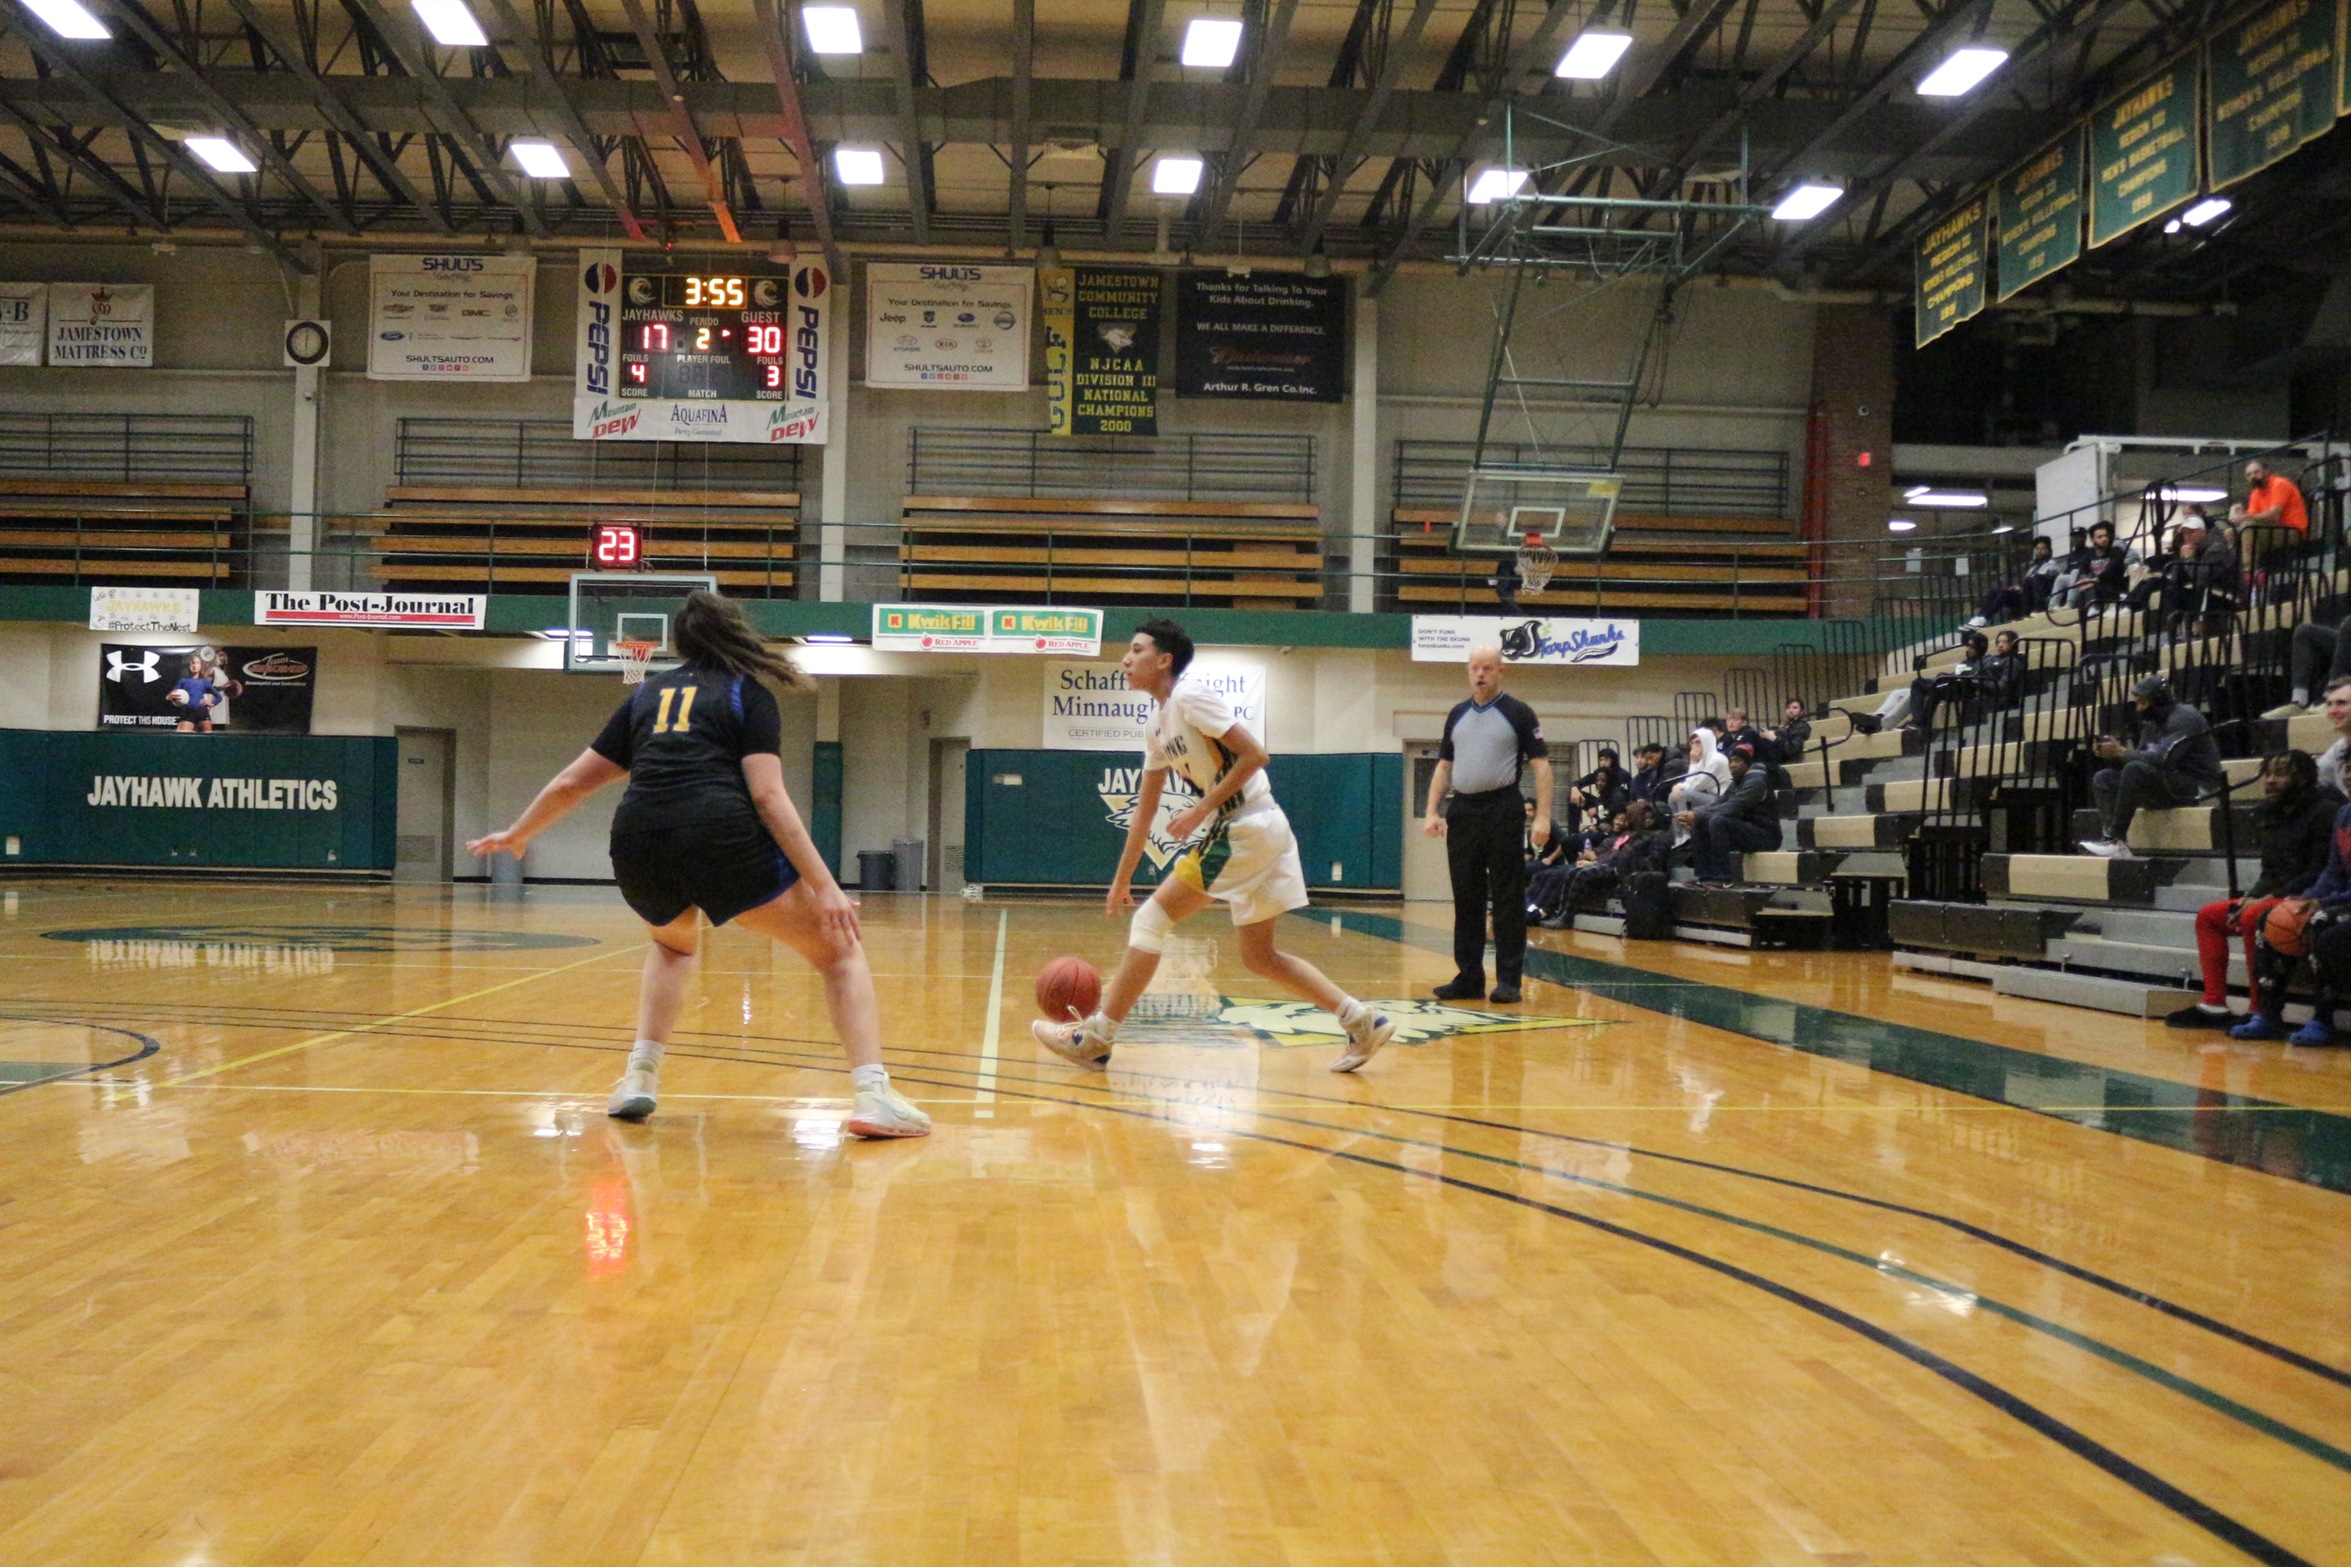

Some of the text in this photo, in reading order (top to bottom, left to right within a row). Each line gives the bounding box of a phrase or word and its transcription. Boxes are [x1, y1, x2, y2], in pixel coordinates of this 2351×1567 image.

[1922, 202, 1981, 255] JAYHAWKS
[423, 257, 483, 271] SHULTS
[919, 267, 981, 281] SHULTS
[1079, 274, 1159, 288] JAMESTOWN
[391, 290, 411, 298] Your
[413, 290, 461, 298] Destination
[480, 291, 513, 300] Savings
[685, 277, 743, 305] 3:55
[1196, 282, 1327, 295] Thanks for Talking To Your
[888, 298, 1012, 309] Your Destination for Savings
[1078, 290, 1159, 304] COMMUNITY
[1209, 295, 1314, 308] Kids About Drinking.
[462, 309, 490, 317] GMC
[622, 309, 684, 321] JAYHAWKS
[741, 311, 780, 323] GUEST
[879, 313, 907, 324] Jeep
[1089, 306, 1148, 320] COLLEGE
[689, 316, 719, 326] PERIOD
[1196, 322, 1211, 331] WE
[1213, 323, 1229, 331] ALL
[1232, 323, 1257, 332] MAKE
[1261, 324, 1268, 332] A
[57, 326, 143, 341] JAMESTOWN
[643, 324, 667, 349] 17
[696, 327, 710, 349] 2
[747, 326, 781, 353] 30
[55, 345, 126, 359] MATTRESS
[587, 300, 610, 395] PEPSI
[795, 305, 819, 399] PEPSI
[406, 355, 494, 364] SHULTSAUTO.COM
[677, 354, 731, 364] PLAYER FOUL
[757, 356, 783, 365] FOULS
[631, 364, 645, 382] 4
[767, 365, 779, 386] 3
[904, 364, 993, 373] SHULTSAUTO.COM
[1046, 325, 1067, 429] GOLF
[1076, 373, 1156, 387] DIVISION III
[621, 388, 648, 397] SCORE
[688, 389, 717, 398] MATCH
[756, 390, 783, 399] SCORE
[1204, 382, 1239, 391] Arthur
[1241, 383, 1251, 392] R.
[1254, 384, 1279, 393] Gren
[1084, 388, 1148, 402] NATIONAL
[588, 401, 637, 427] Mountain
[766, 404, 815, 430] Mountain
[1077, 404, 1154, 417] CHAMPIONS
[1100, 420, 1132, 432] 2000
[599, 531, 634, 560] 23
[106, 600, 181, 613] JAYHAWKS
[266, 592, 474, 614] The Post-Journal
[108, 620, 191, 632] #ProtectTheNest
[908, 614, 950, 630] Kwik
[952, 614, 976, 631] Fill
[1021, 615, 1063, 631] Kwik
[1065, 617, 1088, 632] Fill
[935, 638, 978, 647] RED APPLE
[1048, 640, 1090, 649] RED APPLE
[653, 686, 698, 734] 11
[104, 715, 137, 725] PROTECT
[138, 716, 151, 725] THIS
[1068, 729, 1121, 738] CERTIFIED
[87, 775, 338, 811] JAYHAWK ATHLETICS
